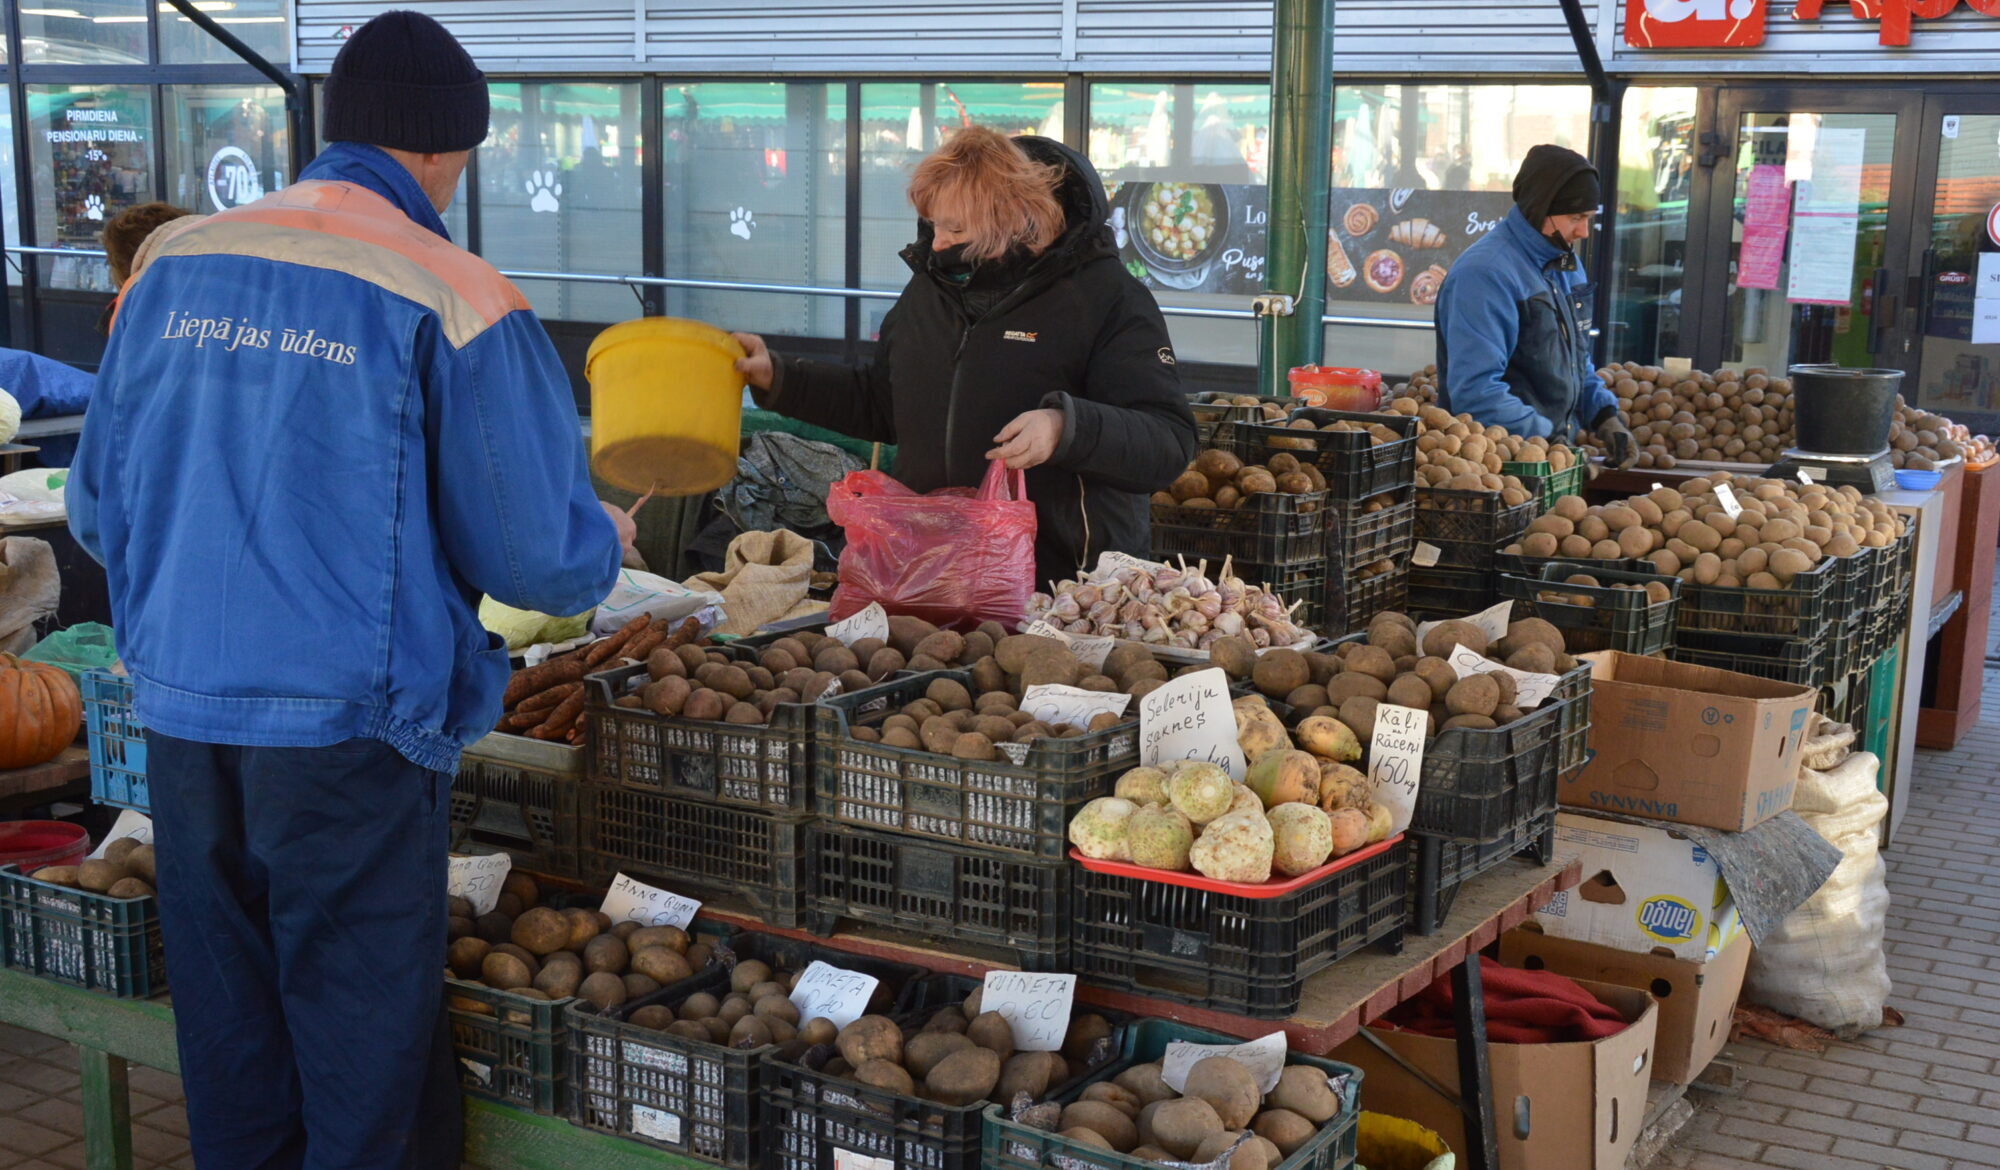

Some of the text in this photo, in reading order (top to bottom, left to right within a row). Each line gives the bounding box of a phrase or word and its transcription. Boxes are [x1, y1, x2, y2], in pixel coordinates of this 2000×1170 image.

[66, 109, 119, 122] PIRMDIENA
[108, 130, 137, 142] DIENA
[280, 328, 357, 366] ūdens
[1590, 790, 1679, 818] BANANAS
[1638, 898, 1697, 939] Tango
